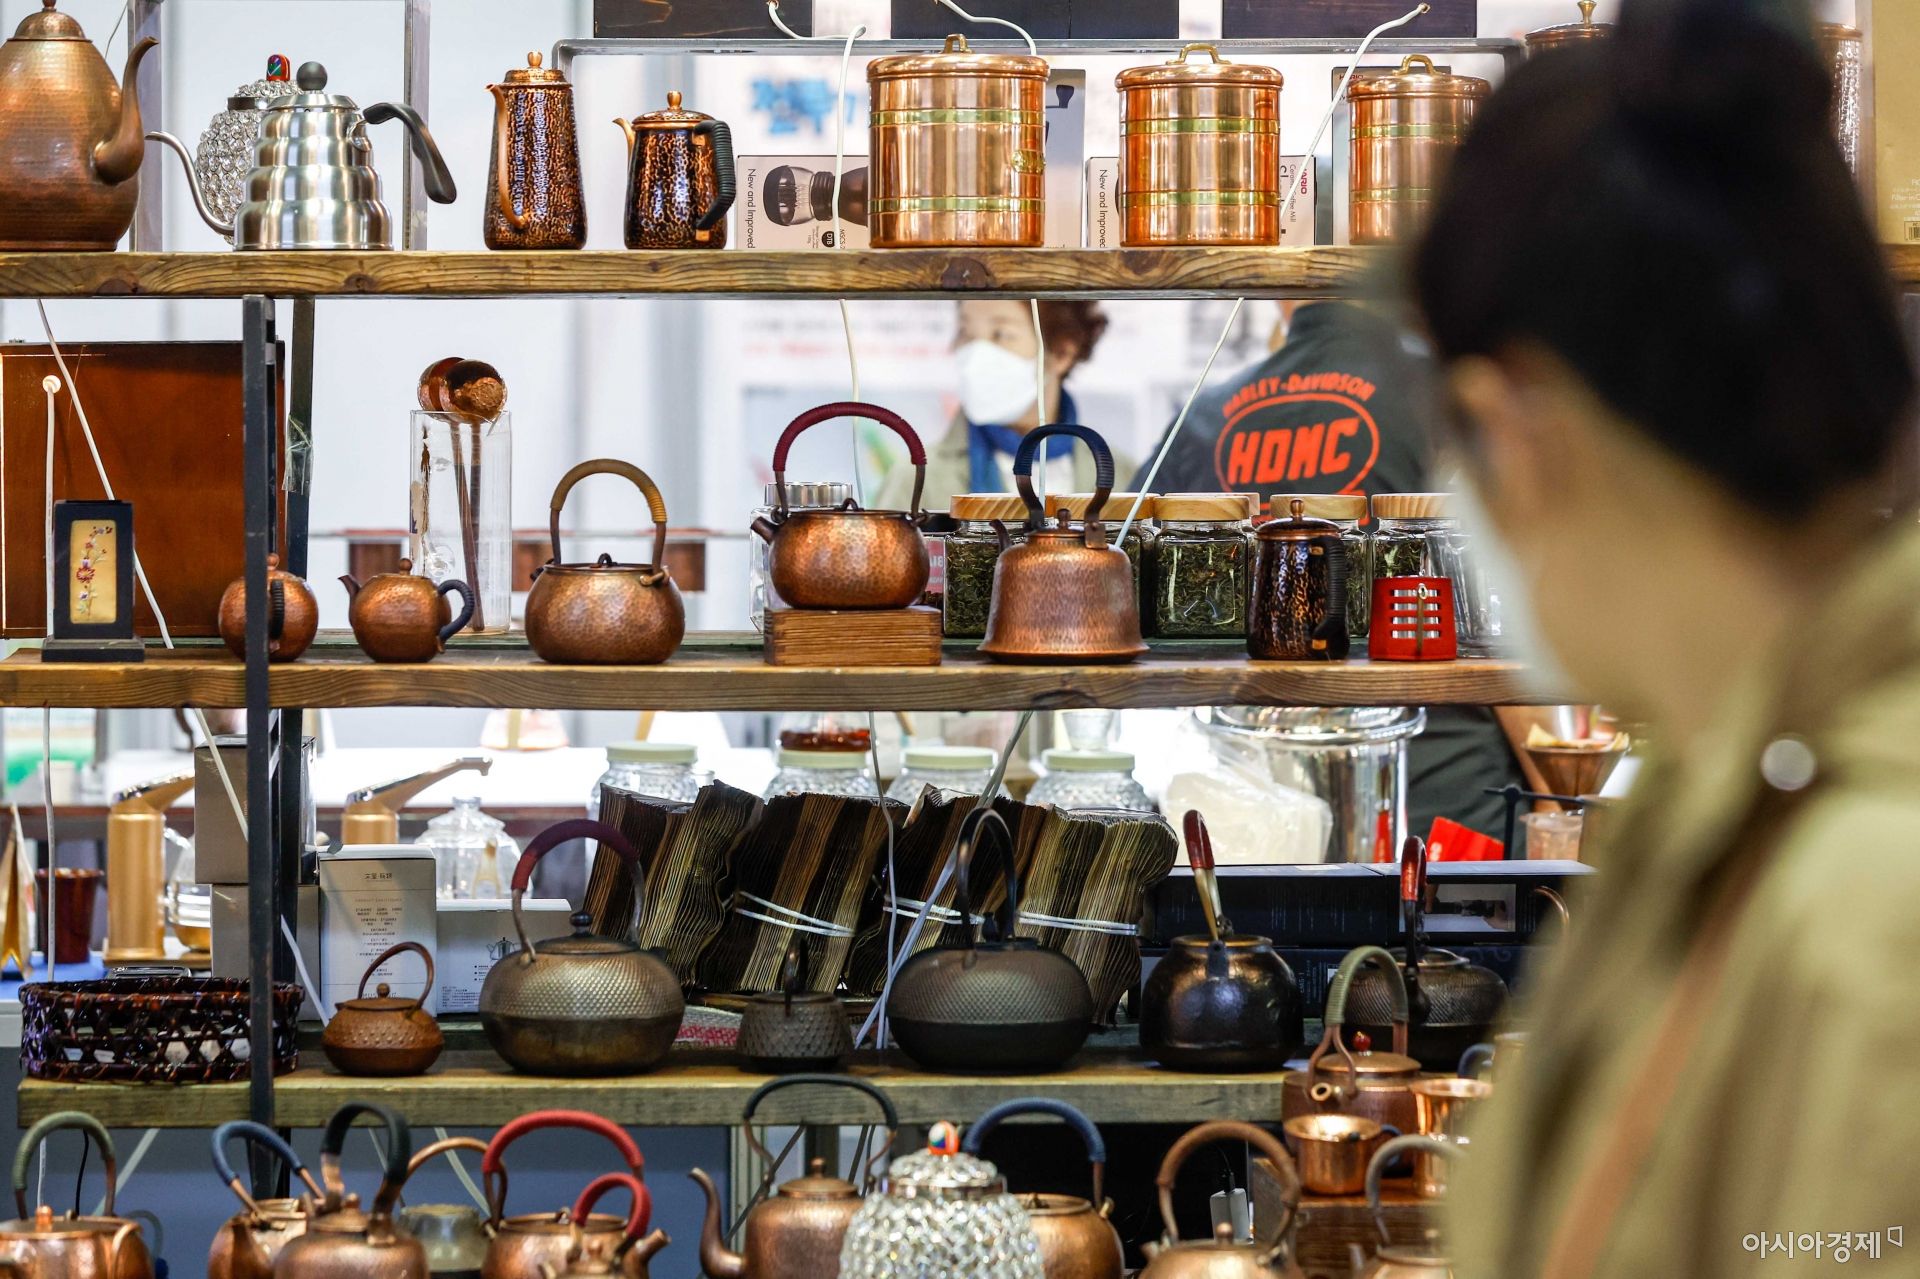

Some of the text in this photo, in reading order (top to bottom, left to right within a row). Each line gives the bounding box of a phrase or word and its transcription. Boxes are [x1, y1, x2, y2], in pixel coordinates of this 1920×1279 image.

[745, 168, 756, 249] New and Improved
[1097, 169, 1108, 249] New and Improved
[1300, 168, 1308, 195] ARIO
